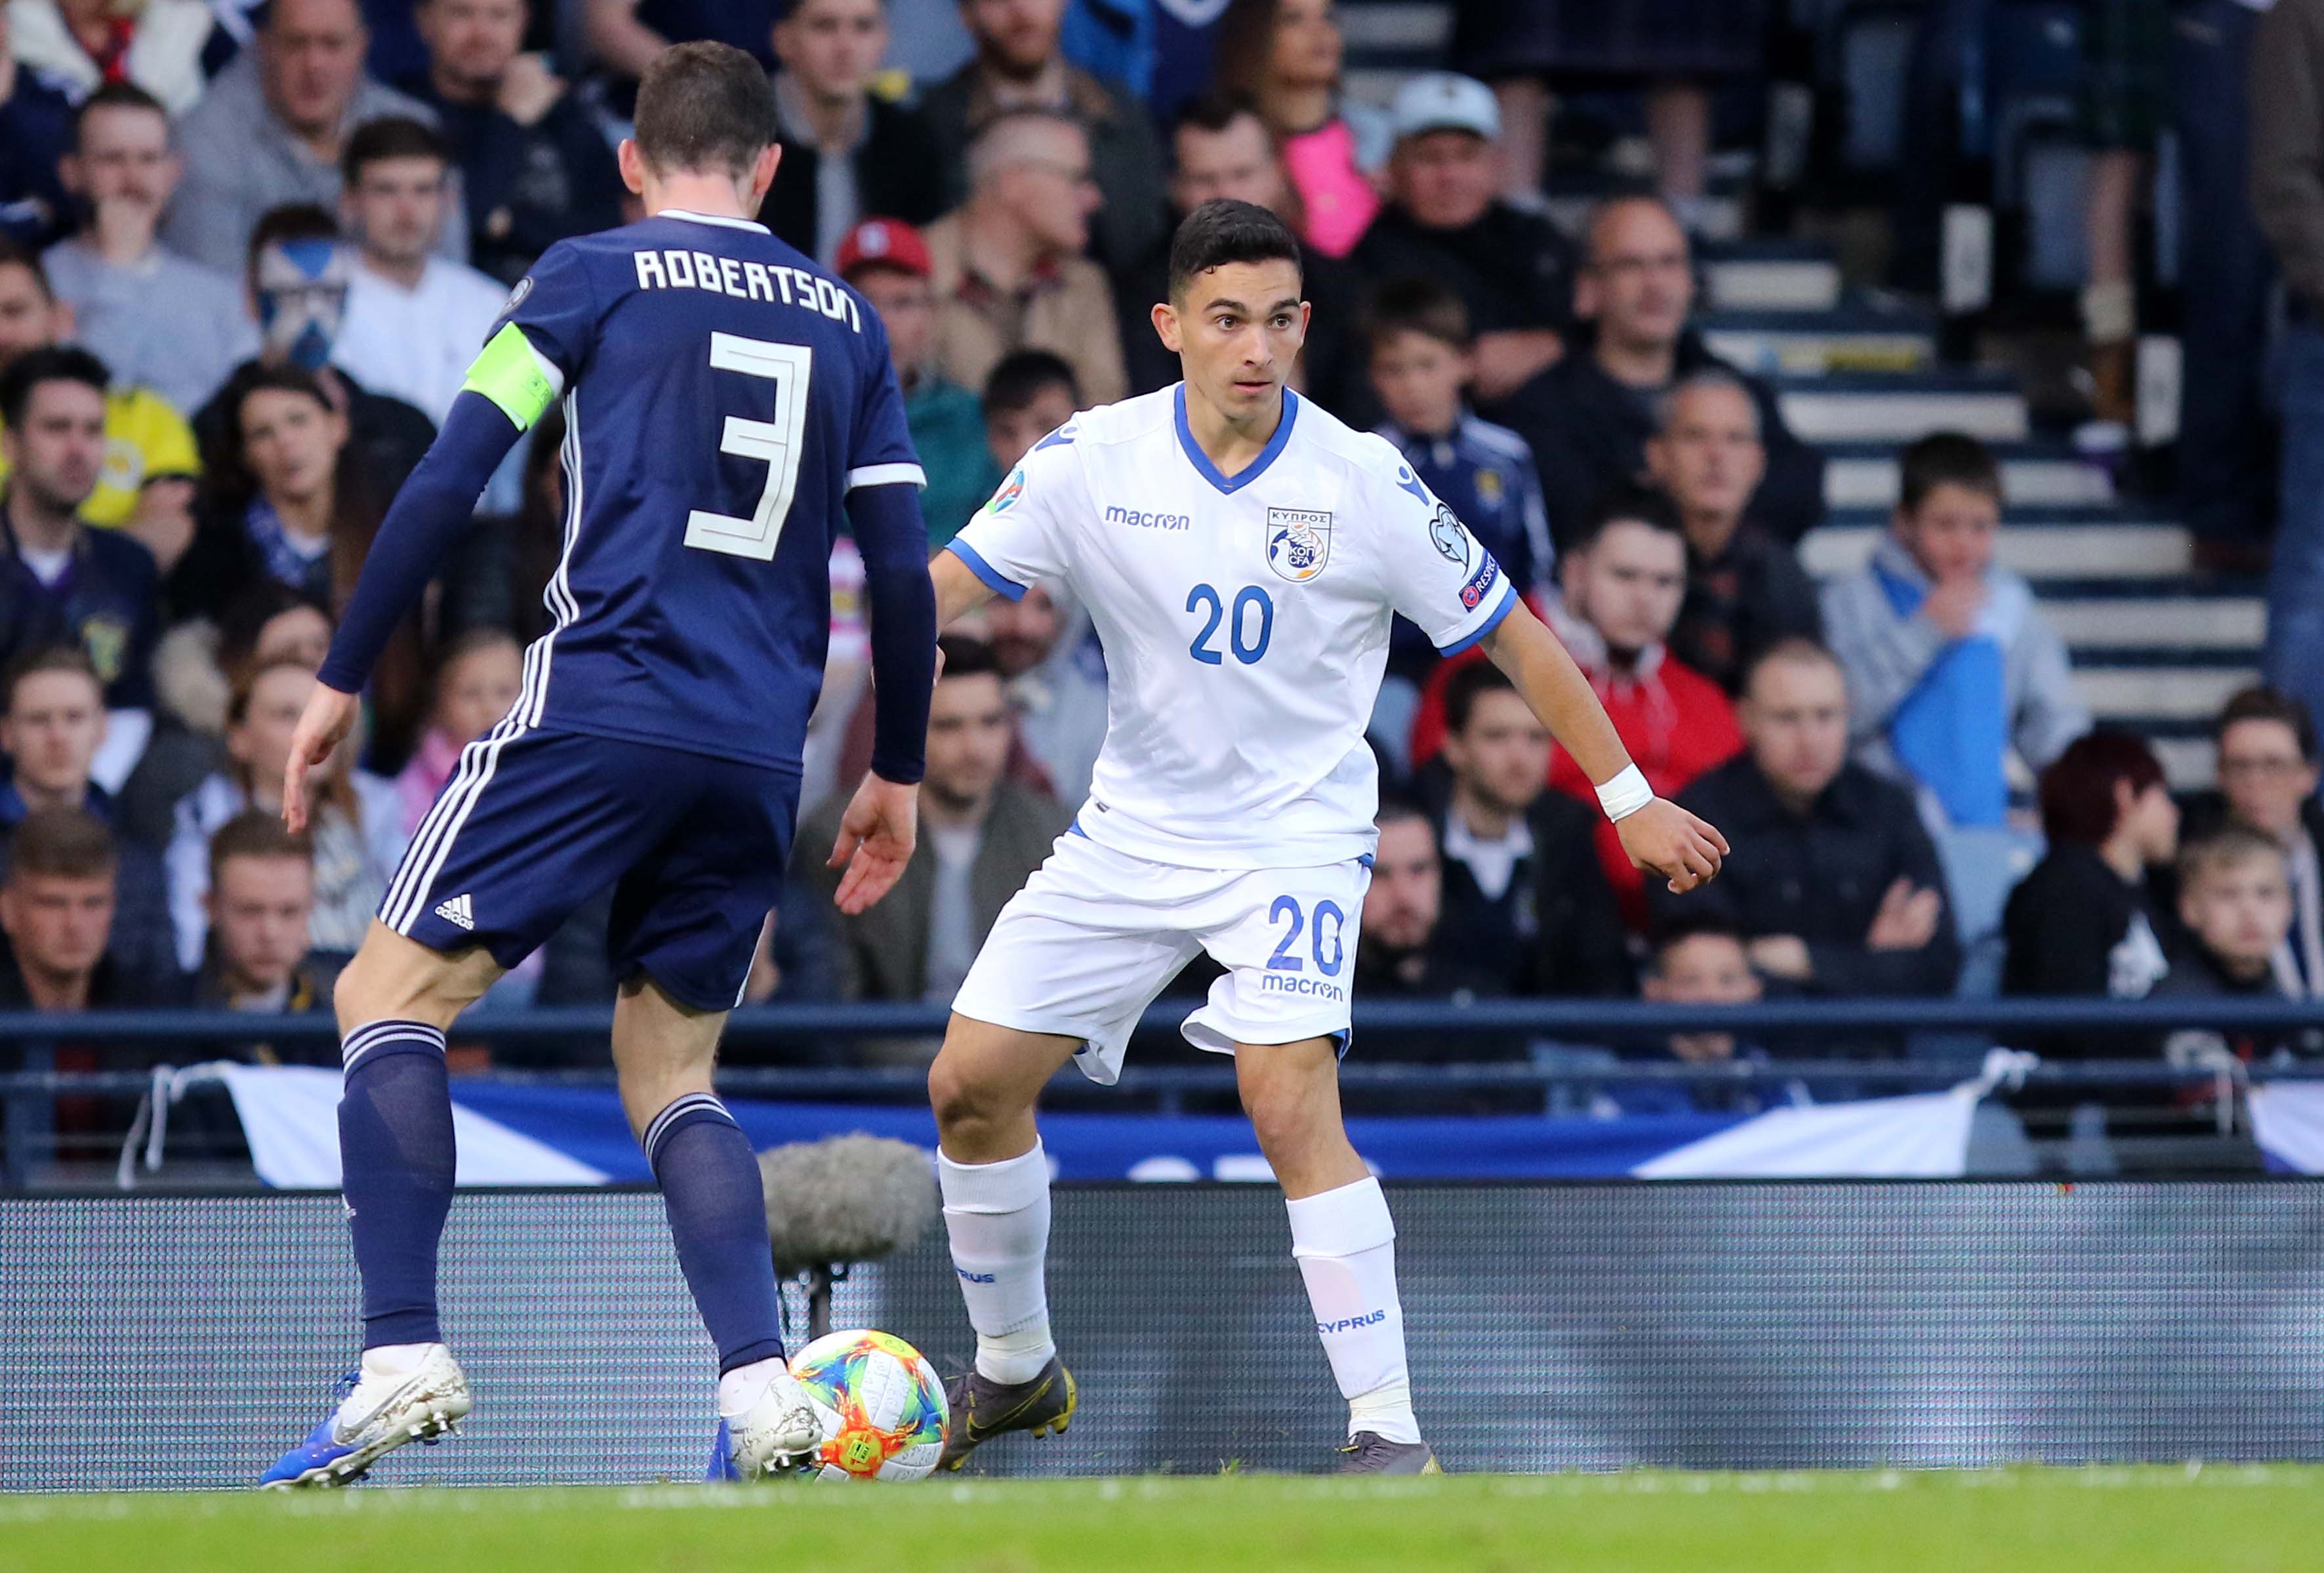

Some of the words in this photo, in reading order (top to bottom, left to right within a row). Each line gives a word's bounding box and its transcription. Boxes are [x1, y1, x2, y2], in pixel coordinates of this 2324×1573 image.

[634, 250, 861, 333] ROBERTSON
[683, 330, 812, 561] 3
[1105, 505, 1190, 531] macron
[1272, 511, 1326, 523] ΚΥΠΡΟΣ
[1288, 556, 1310, 565] CFA
[1290, 546, 1315, 557] ΚΟΠ
[1186, 583, 1273, 664] 20
[434, 906, 474, 931] adidas
[1266, 895, 1344, 977] 20
[1261, 974, 1343, 1002] macron
[954, 1266, 995, 1283] RUS
[1316, 1309, 1385, 1334] CYPRUS
